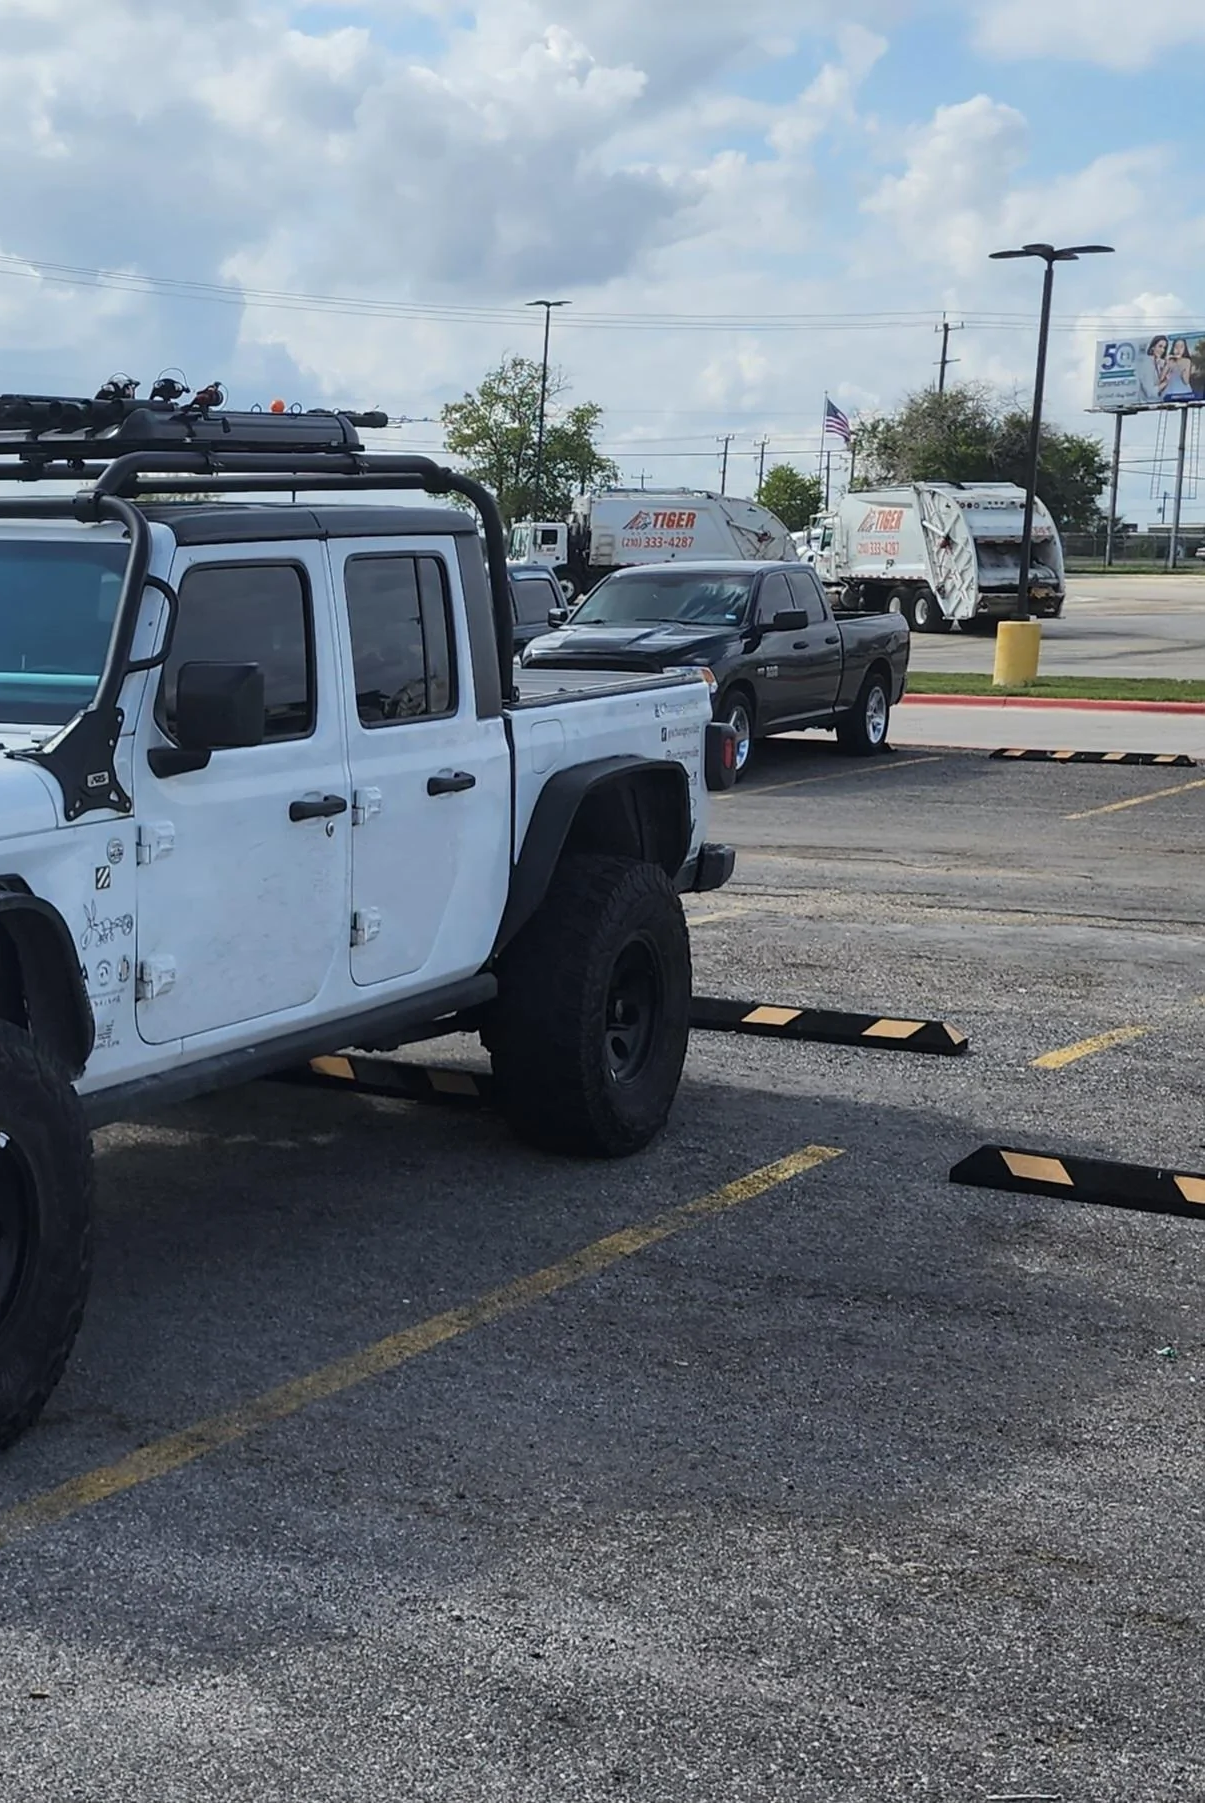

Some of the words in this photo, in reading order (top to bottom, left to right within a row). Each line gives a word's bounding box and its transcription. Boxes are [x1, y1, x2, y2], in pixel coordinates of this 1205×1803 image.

[653, 512, 696, 528] TIGER
[875, 510, 903, 529] TIGER
[644, 536, 694, 548] 333-4287
